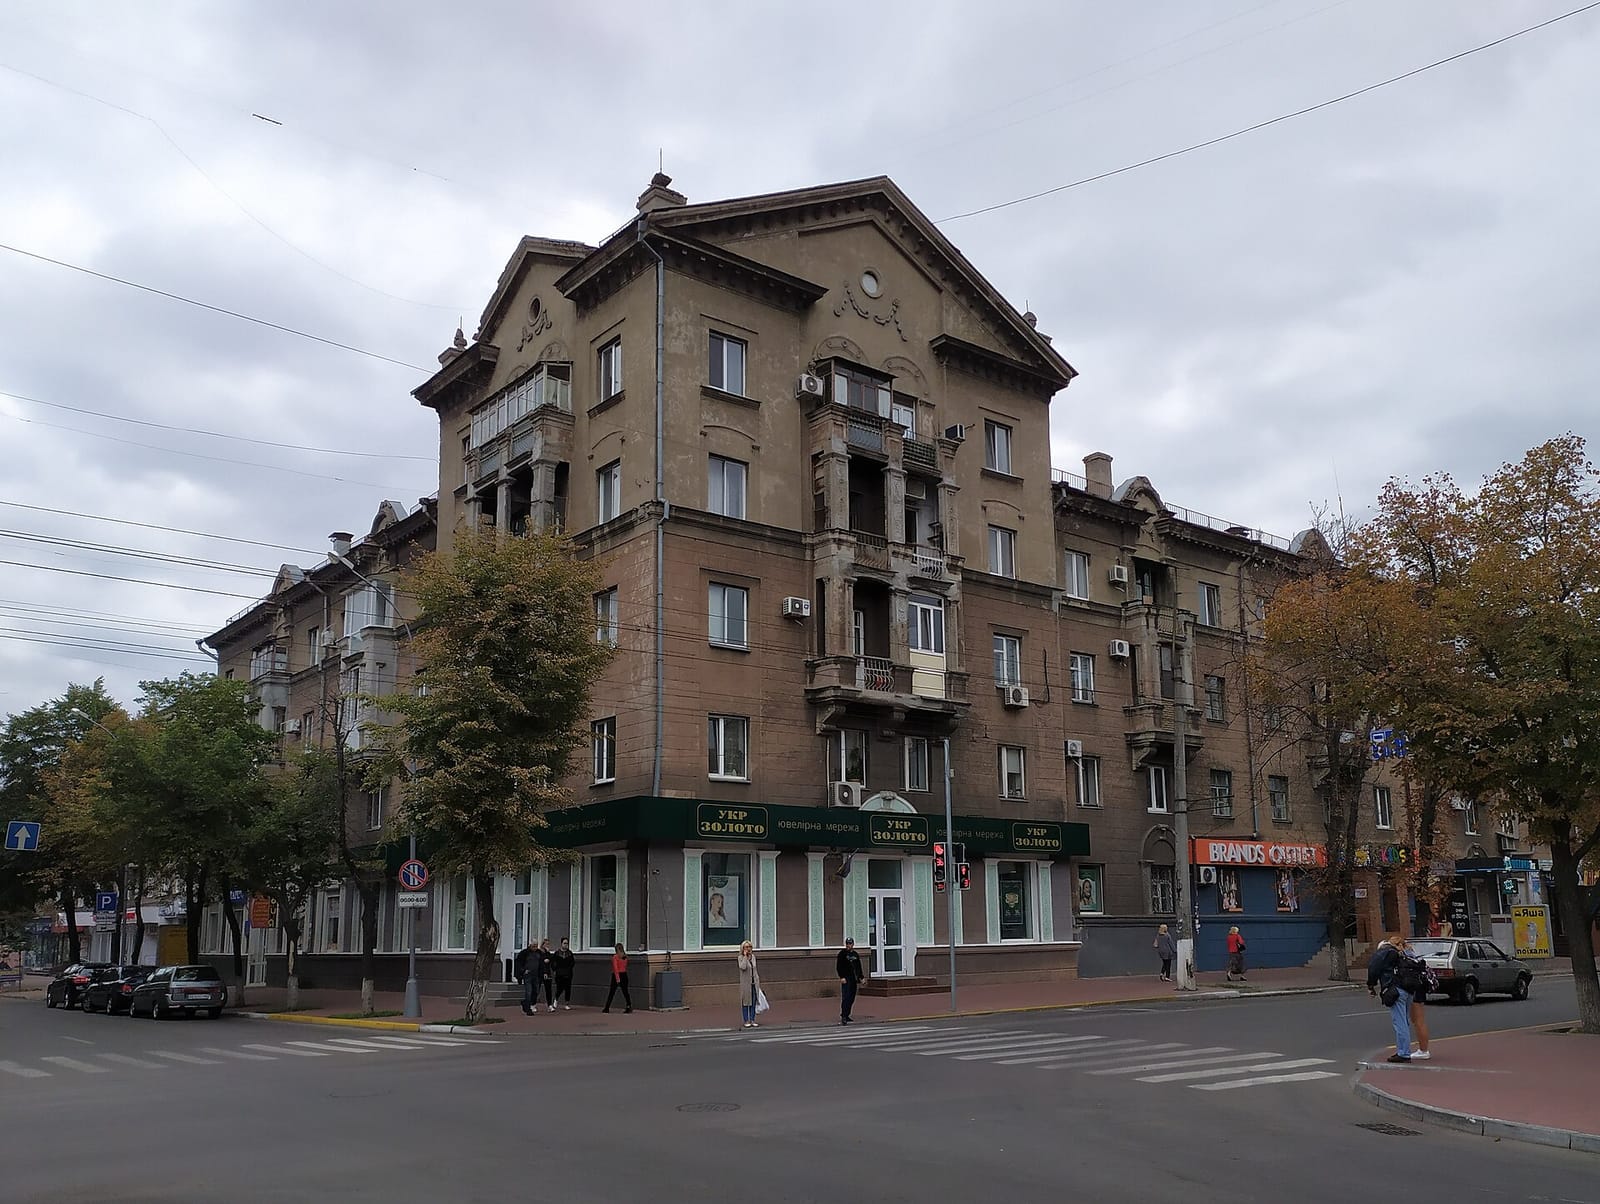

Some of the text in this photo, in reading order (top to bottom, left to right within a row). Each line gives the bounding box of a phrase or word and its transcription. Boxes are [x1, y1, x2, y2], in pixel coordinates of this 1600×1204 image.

[718, 809, 748, 821] УКР
[700, 821, 765, 835] ЗОЛОТО
[777, 819, 860, 834] ювелірна мережа
[887, 820, 912, 830] УКР
[873, 830, 926, 842] ЗОЛОТО
[1026, 827, 1048, 836] УКР
[1015, 836, 1060, 848] ЗОЛОТО
[1209, 843, 1265, 864] BRANDS
[101, 895, 112, 909] P
[1521, 909, 1544, 918] Яша
[1516, 947, 1549, 955] поїхали
